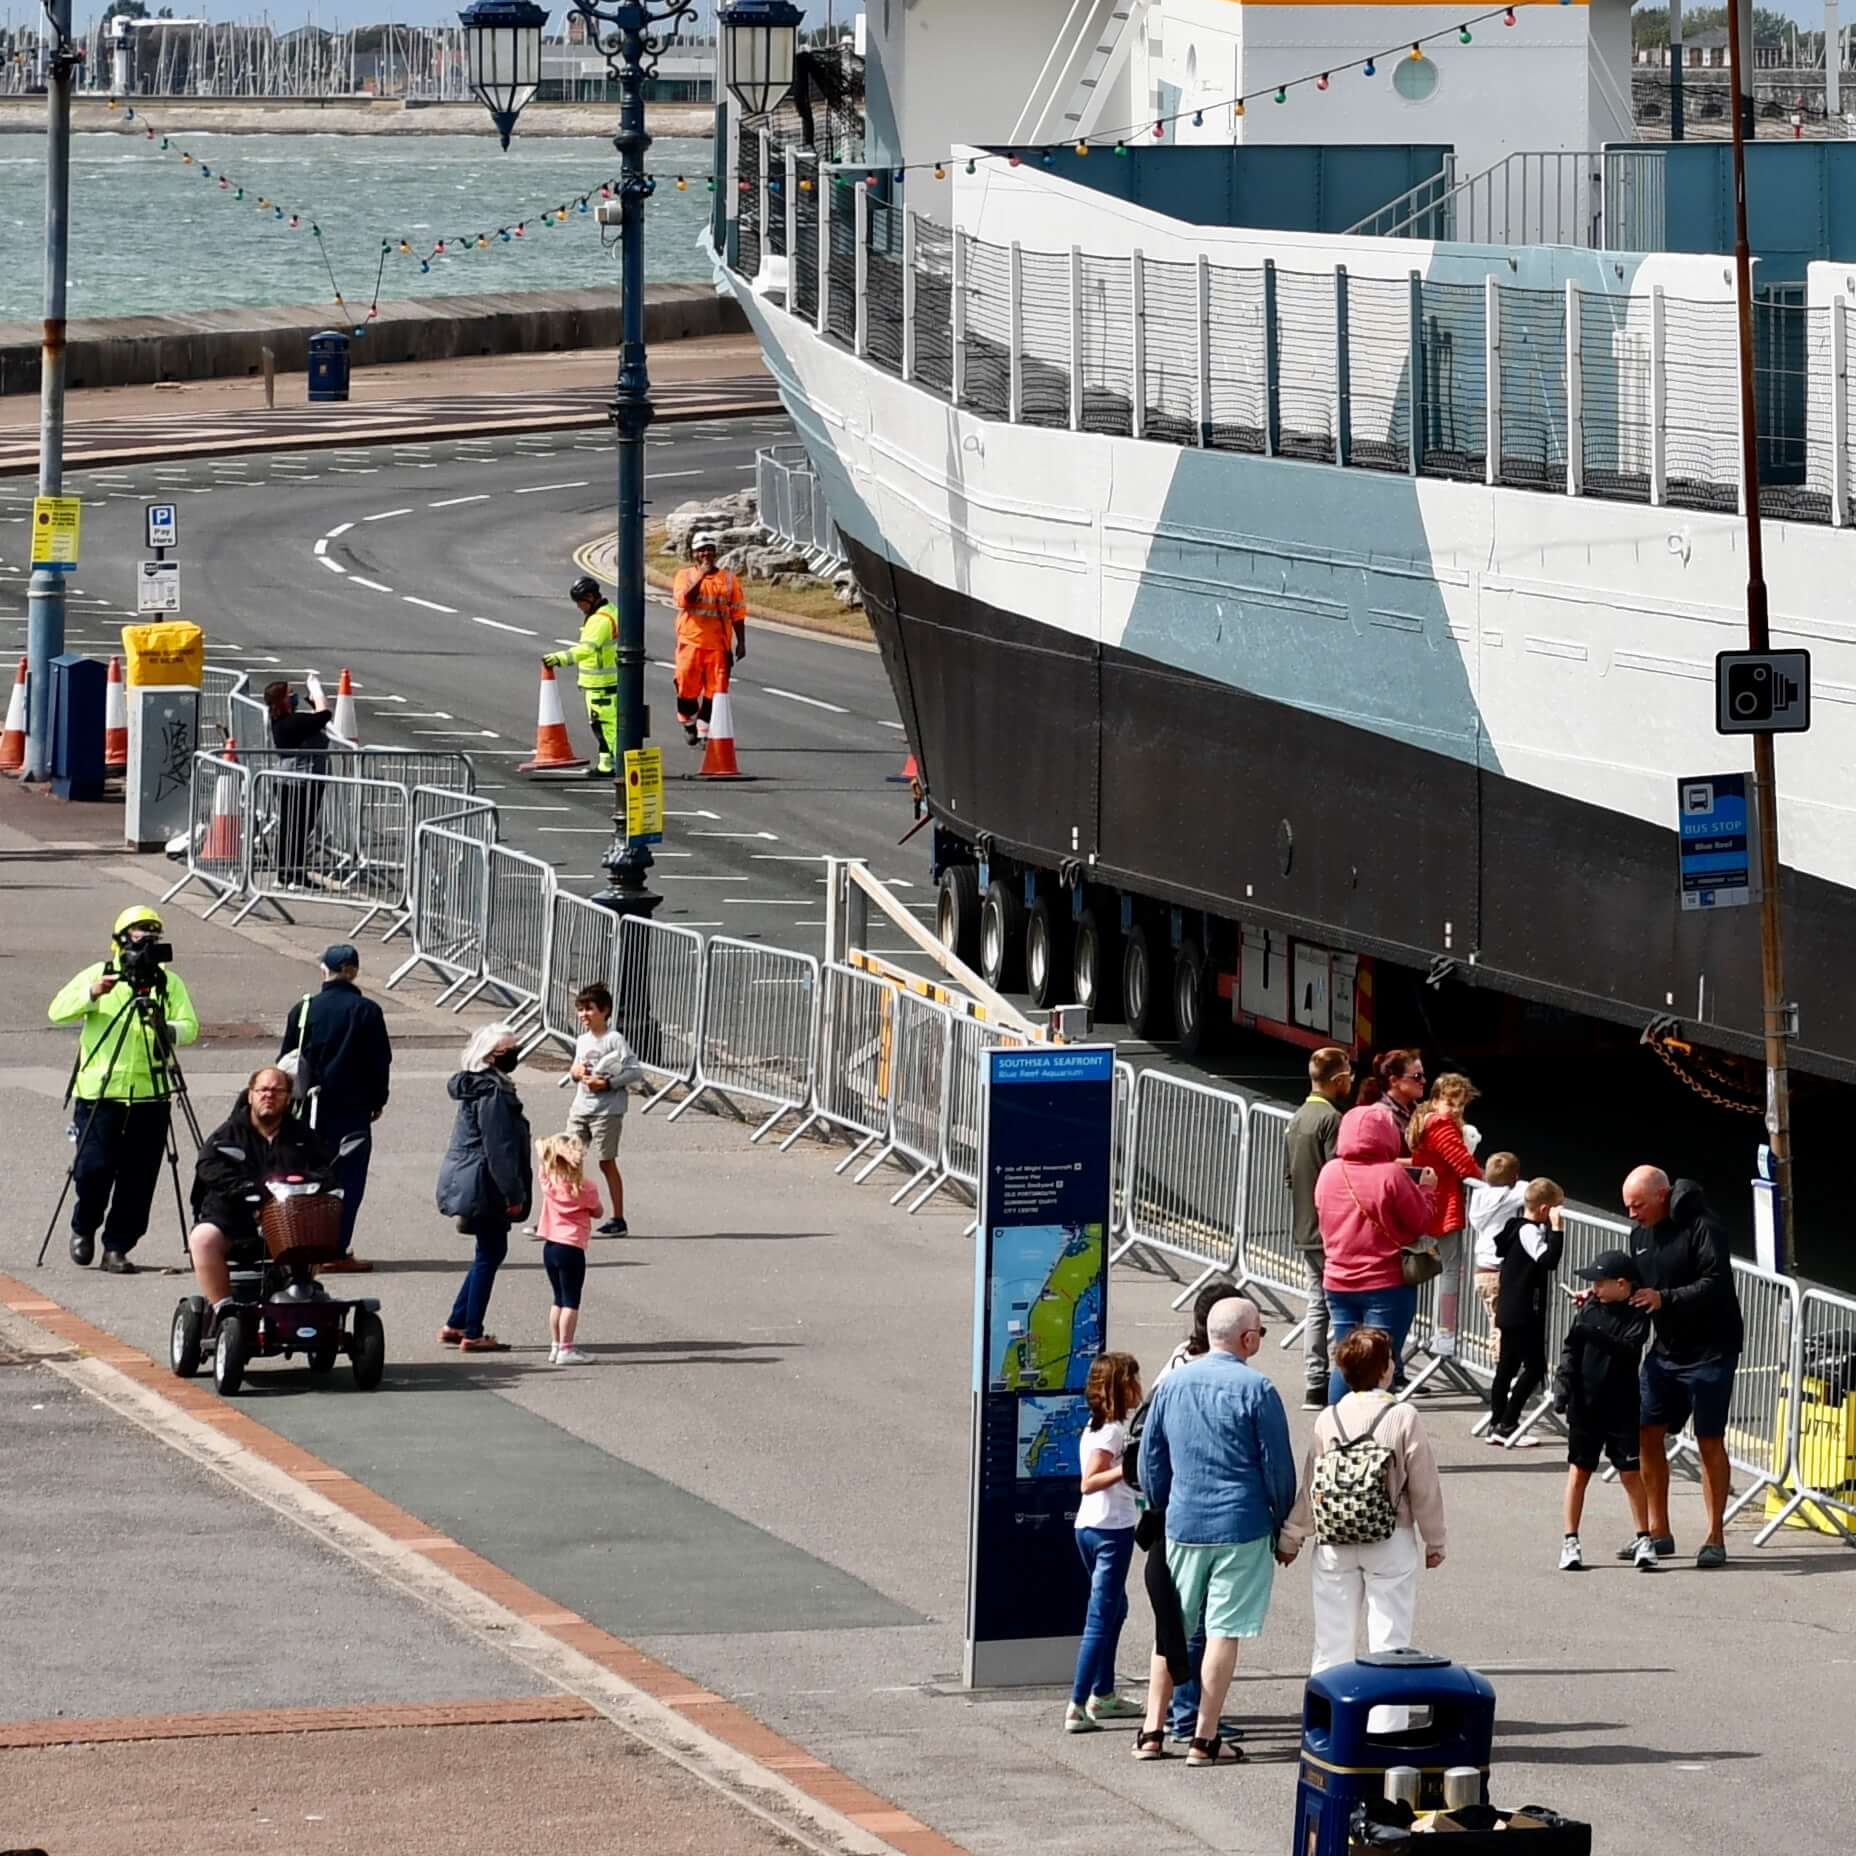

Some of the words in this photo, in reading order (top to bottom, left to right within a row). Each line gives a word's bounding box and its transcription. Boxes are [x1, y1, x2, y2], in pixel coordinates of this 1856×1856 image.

[1684, 824, 1708, 835] BUS
[1711, 820, 1742, 833] STOP
[999, 1058, 1050, 1068] SOUTHSEA
[1053, 1056, 1104, 1066] SEAFRONT
[1042, 1069, 1084, 1077] Aquarium
